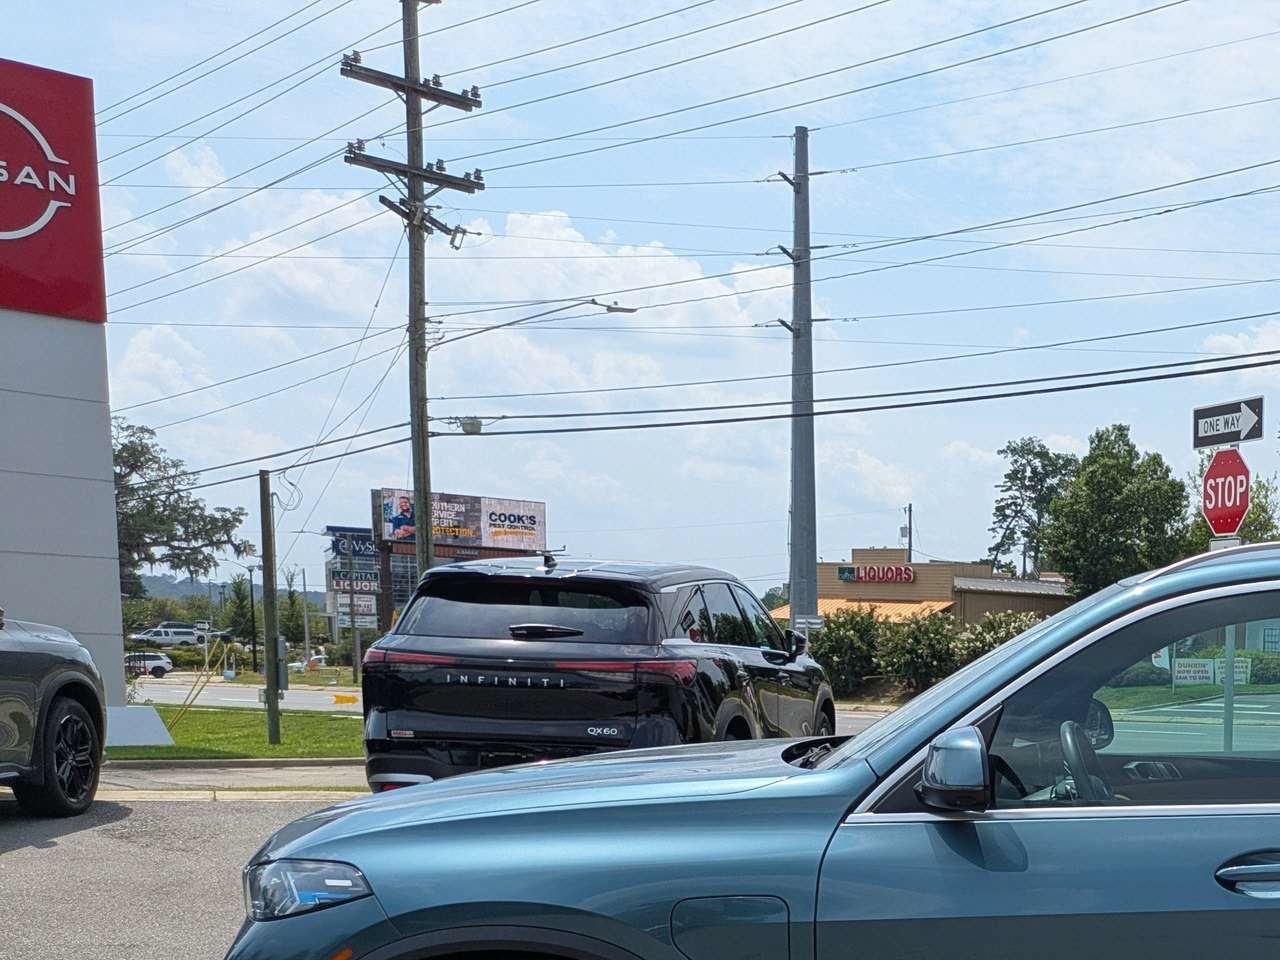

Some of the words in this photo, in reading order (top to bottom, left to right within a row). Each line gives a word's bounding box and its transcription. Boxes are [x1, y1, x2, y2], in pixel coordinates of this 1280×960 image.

[1203, 418, 1220, 434] ONE
[1223, 415, 1241, 431] WAY
[1205, 474, 1247, 510] STOP
[488, 511, 537, 526] COOK'S
[855, 565, 914, 583] LIQUORS
[446, 673, 565, 688] INFINITI
[587, 727, 619, 736] QX60
